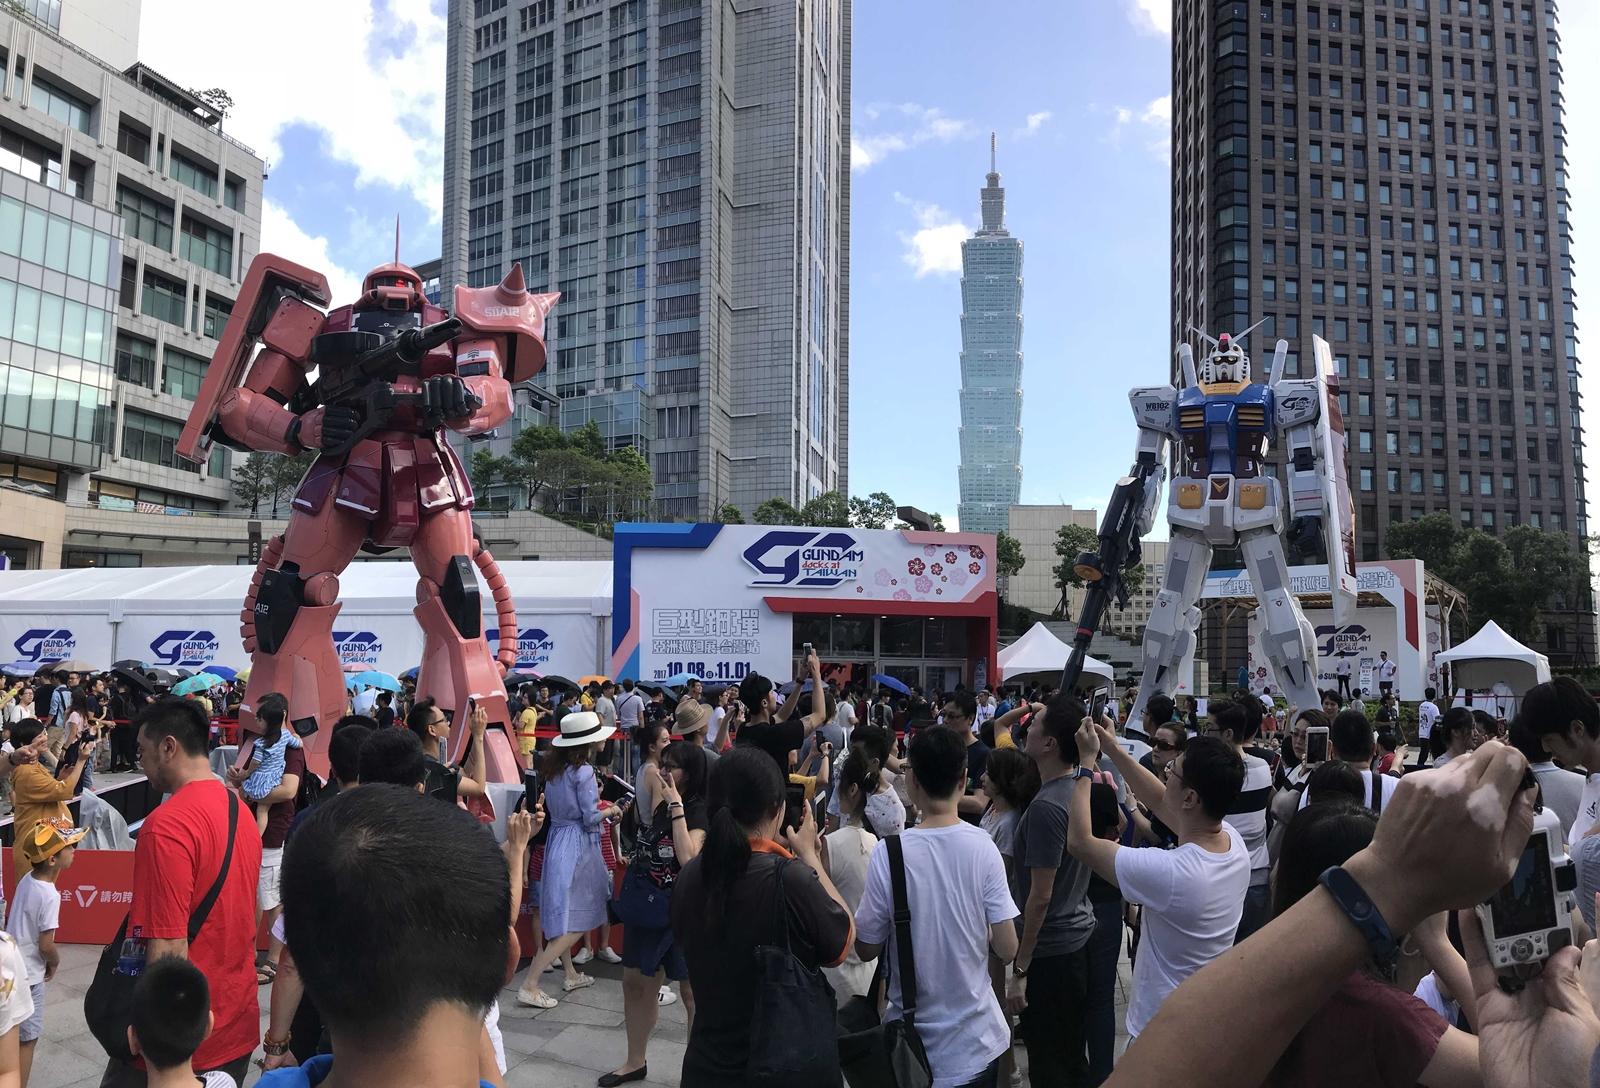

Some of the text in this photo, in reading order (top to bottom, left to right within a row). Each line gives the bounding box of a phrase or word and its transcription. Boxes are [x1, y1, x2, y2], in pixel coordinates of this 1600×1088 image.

[802, 549, 864, 562] GUNDAM
[831, 561, 841, 569] at
[802, 568, 857, 577] TAIWAN
[652, 608, 760, 637] 巨型鋼彈
[1335, 634, 1371, 642] GUNDAM
[43, 639, 76, 648] GUNDAM
[182, 641, 219, 650] GUNDAM
[341, 643, 382, 652] GUNDAM
[517, 641, 553, 650] UNDAM
[1323, 672, 1352, 680] SUNE
[58, 889, 73, 902] 全
